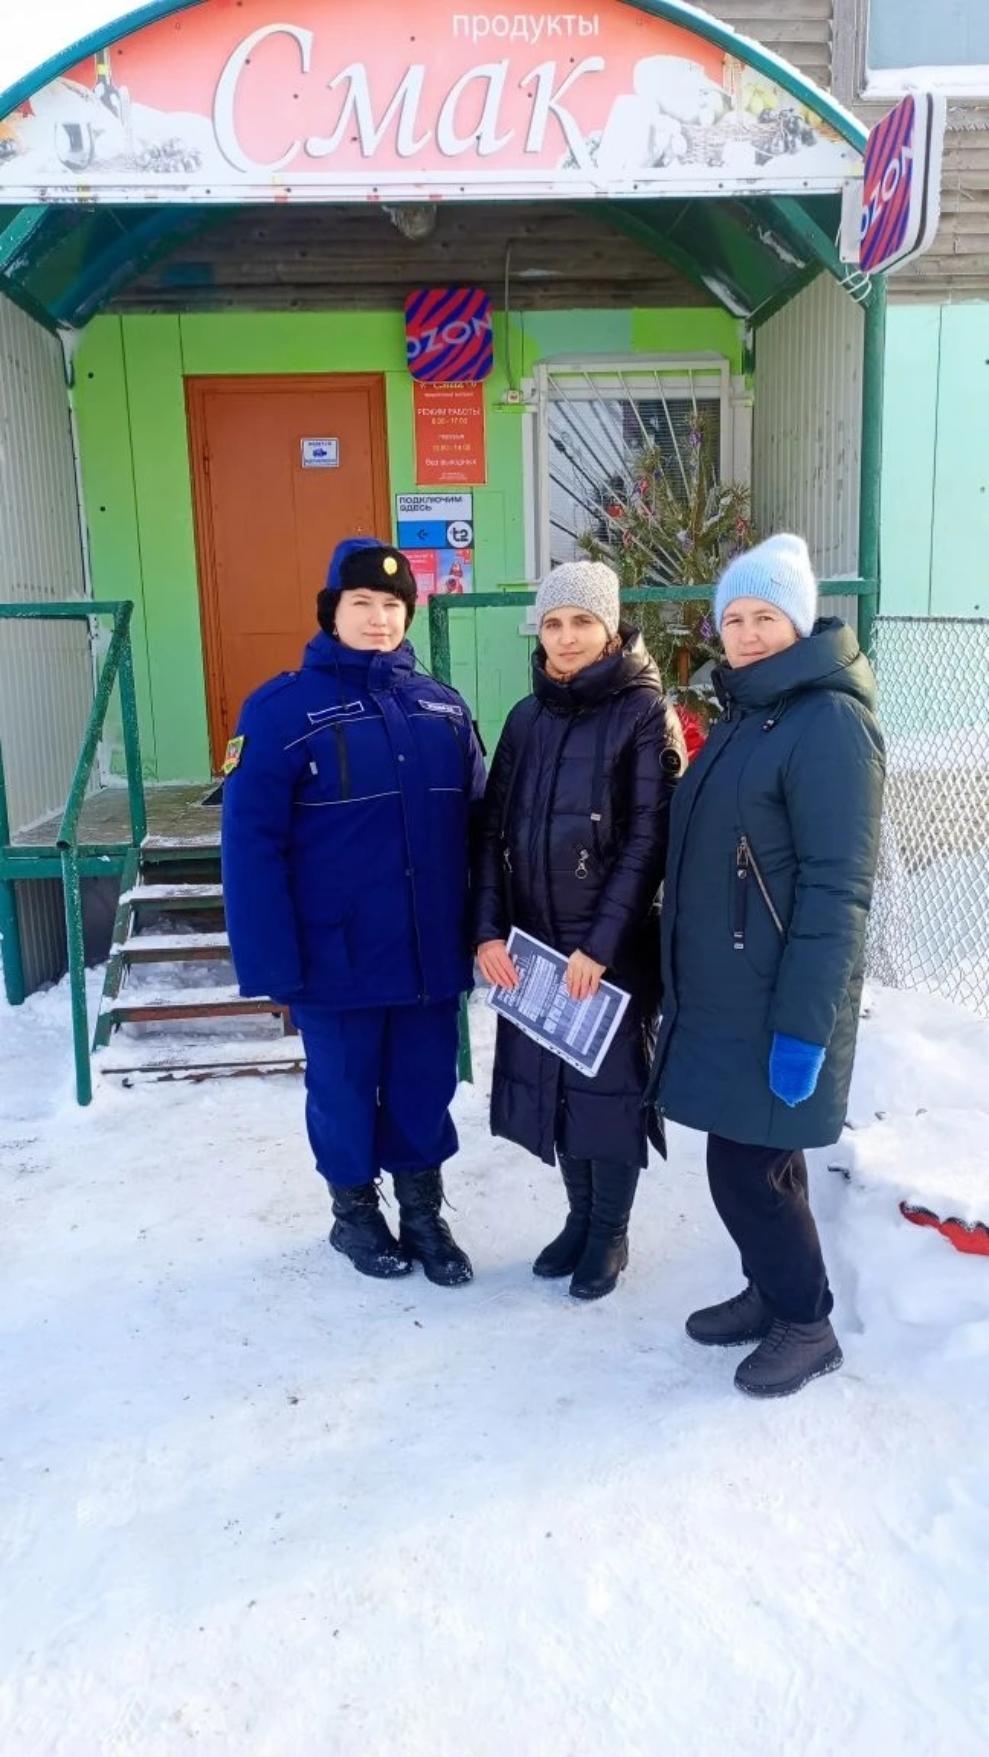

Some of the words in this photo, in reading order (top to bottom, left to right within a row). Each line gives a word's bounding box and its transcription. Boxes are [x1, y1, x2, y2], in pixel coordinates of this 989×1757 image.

[452, 13, 600, 43] продукты
[213, 22, 606, 180] Смак
[406, 312, 492, 359] OZON
[448, 407, 480, 416] РАБОТЫ
[399, 496, 462, 504] ПОДКЛЮЧИМ
[400, 504, 433, 512] ЗДЕСЬ
[452, 527, 469, 542] t2
